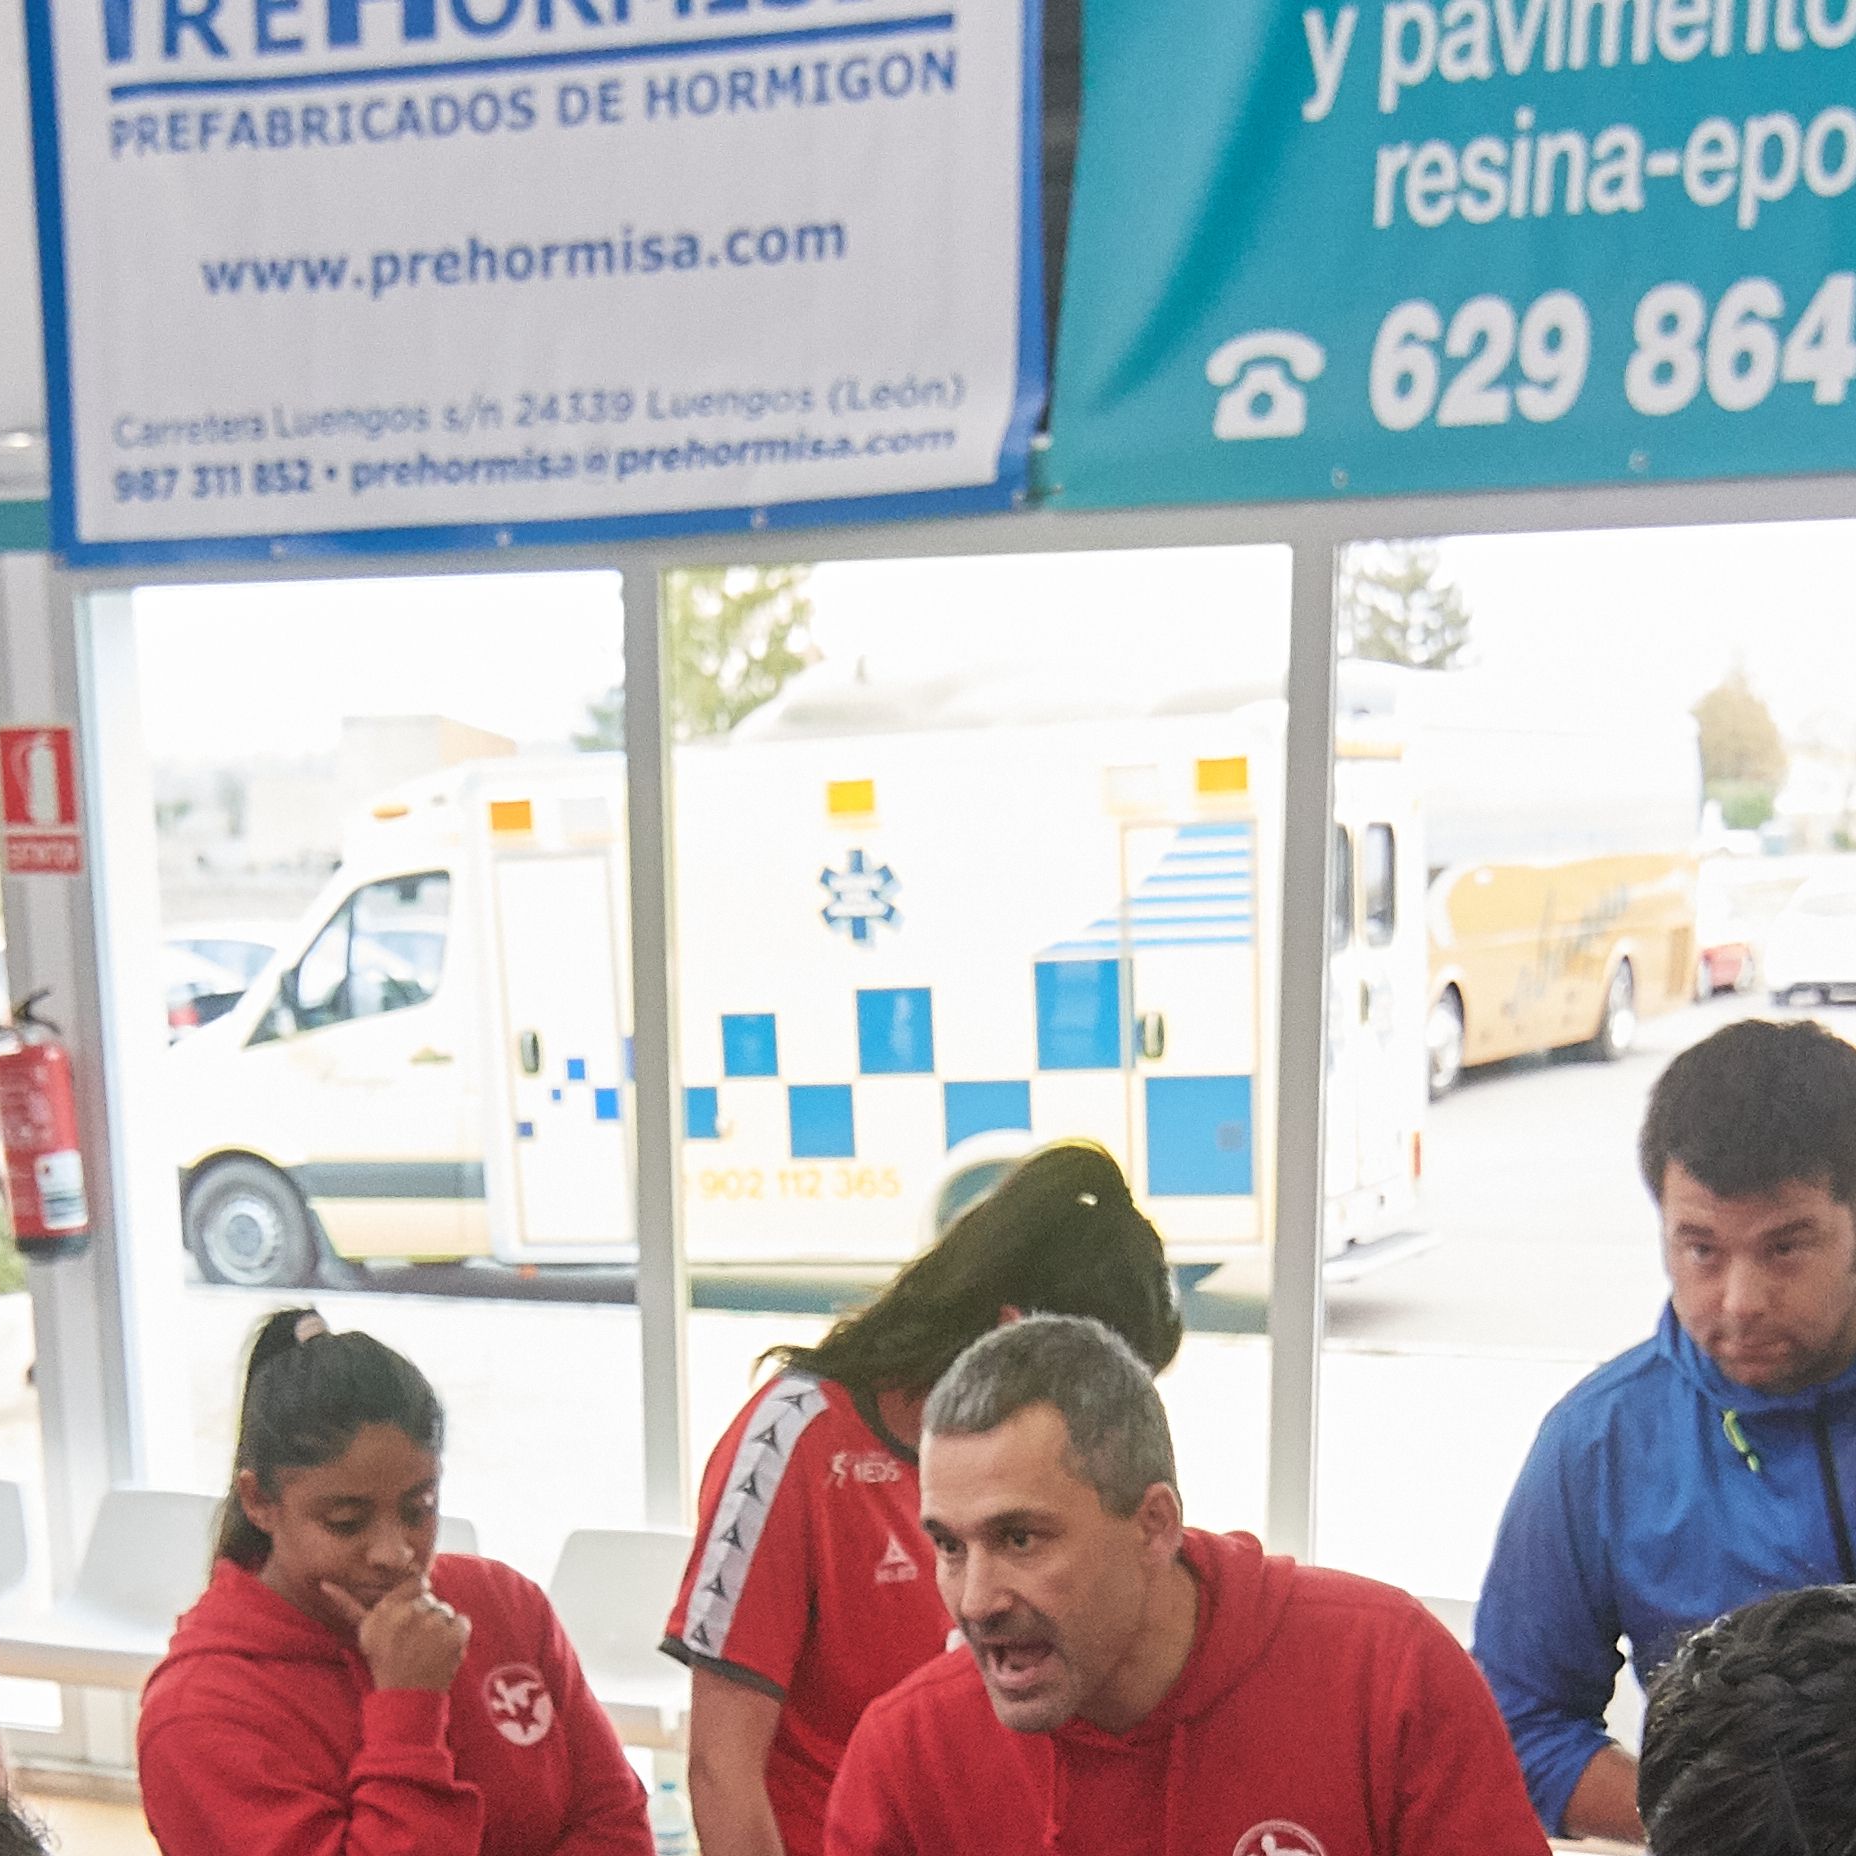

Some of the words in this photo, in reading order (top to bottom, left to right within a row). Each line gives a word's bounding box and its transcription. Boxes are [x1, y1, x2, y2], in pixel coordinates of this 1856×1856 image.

[108, 86, 538, 160] PREFABRICADOS
[556, 80, 624, 126] DE
[644, 47, 959, 120] HORMIGON
[1301, 3, 1358, 122] y
[198, 218, 848, 298] www.prehormisa.com
[1367, 288, 1592, 432] 629
[112, 462, 180, 503] 987
[698, 1167, 765, 1202] 902
